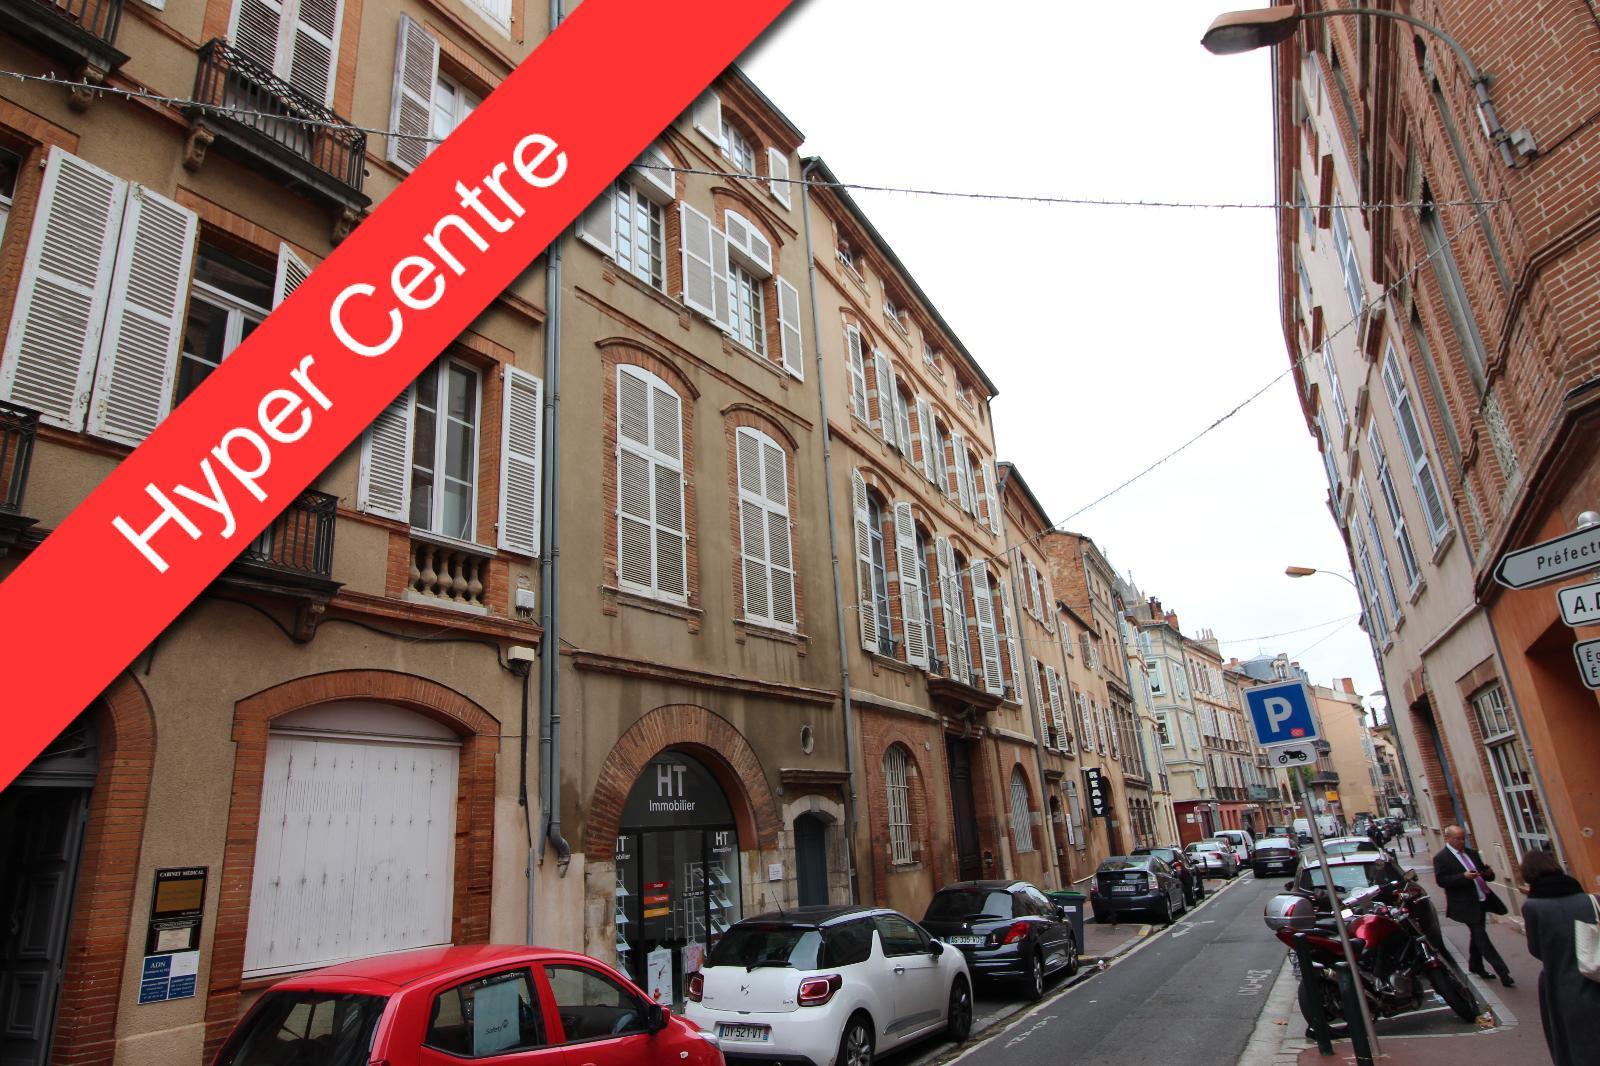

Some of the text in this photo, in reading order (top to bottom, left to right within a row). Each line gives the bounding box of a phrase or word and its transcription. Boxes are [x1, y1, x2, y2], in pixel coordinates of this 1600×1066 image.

[1263, 696, 1292, 733] P
[657, 764, 687, 796] HT
[1088, 771, 1104, 815] READY
[649, 799, 696, 811] Immobilier
[715, 831, 729, 846] HT
[150, 961, 166, 969] ADN
